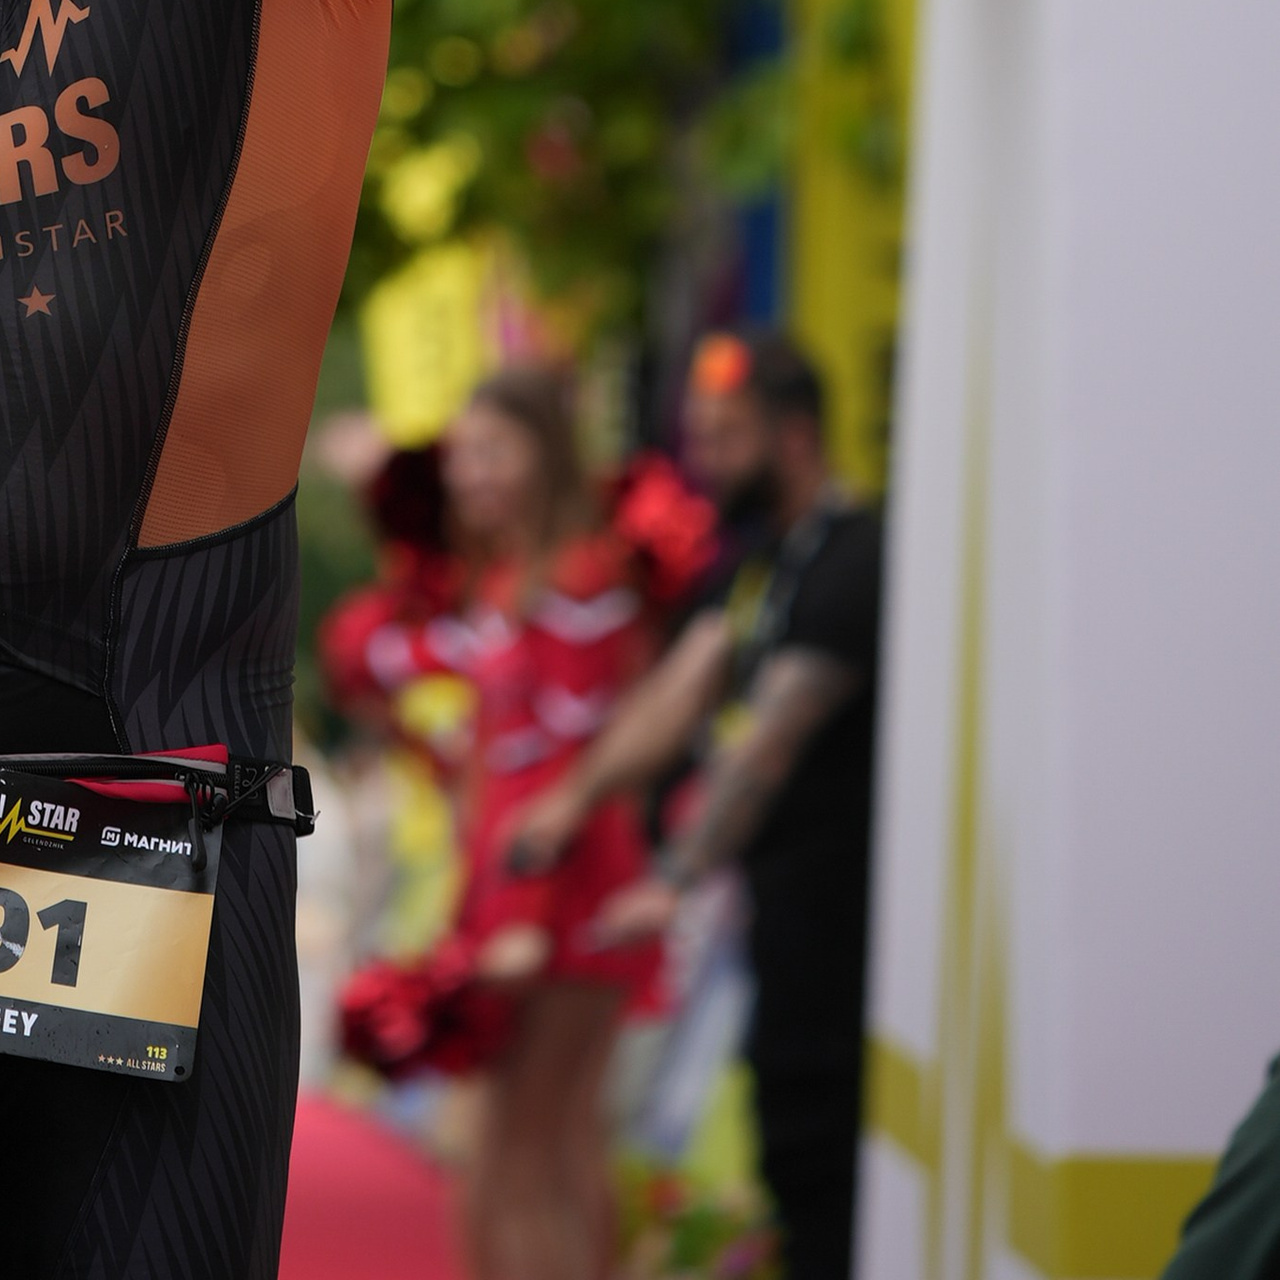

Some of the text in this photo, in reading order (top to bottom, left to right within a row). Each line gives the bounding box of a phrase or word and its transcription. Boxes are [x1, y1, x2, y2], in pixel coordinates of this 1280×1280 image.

[27, 800, 81, 832] STAR
[22, 836, 65, 850] GELENDZHIK
[146, 1046, 168, 1060] 113
[126, 1058, 167, 1073] ALL STARS
